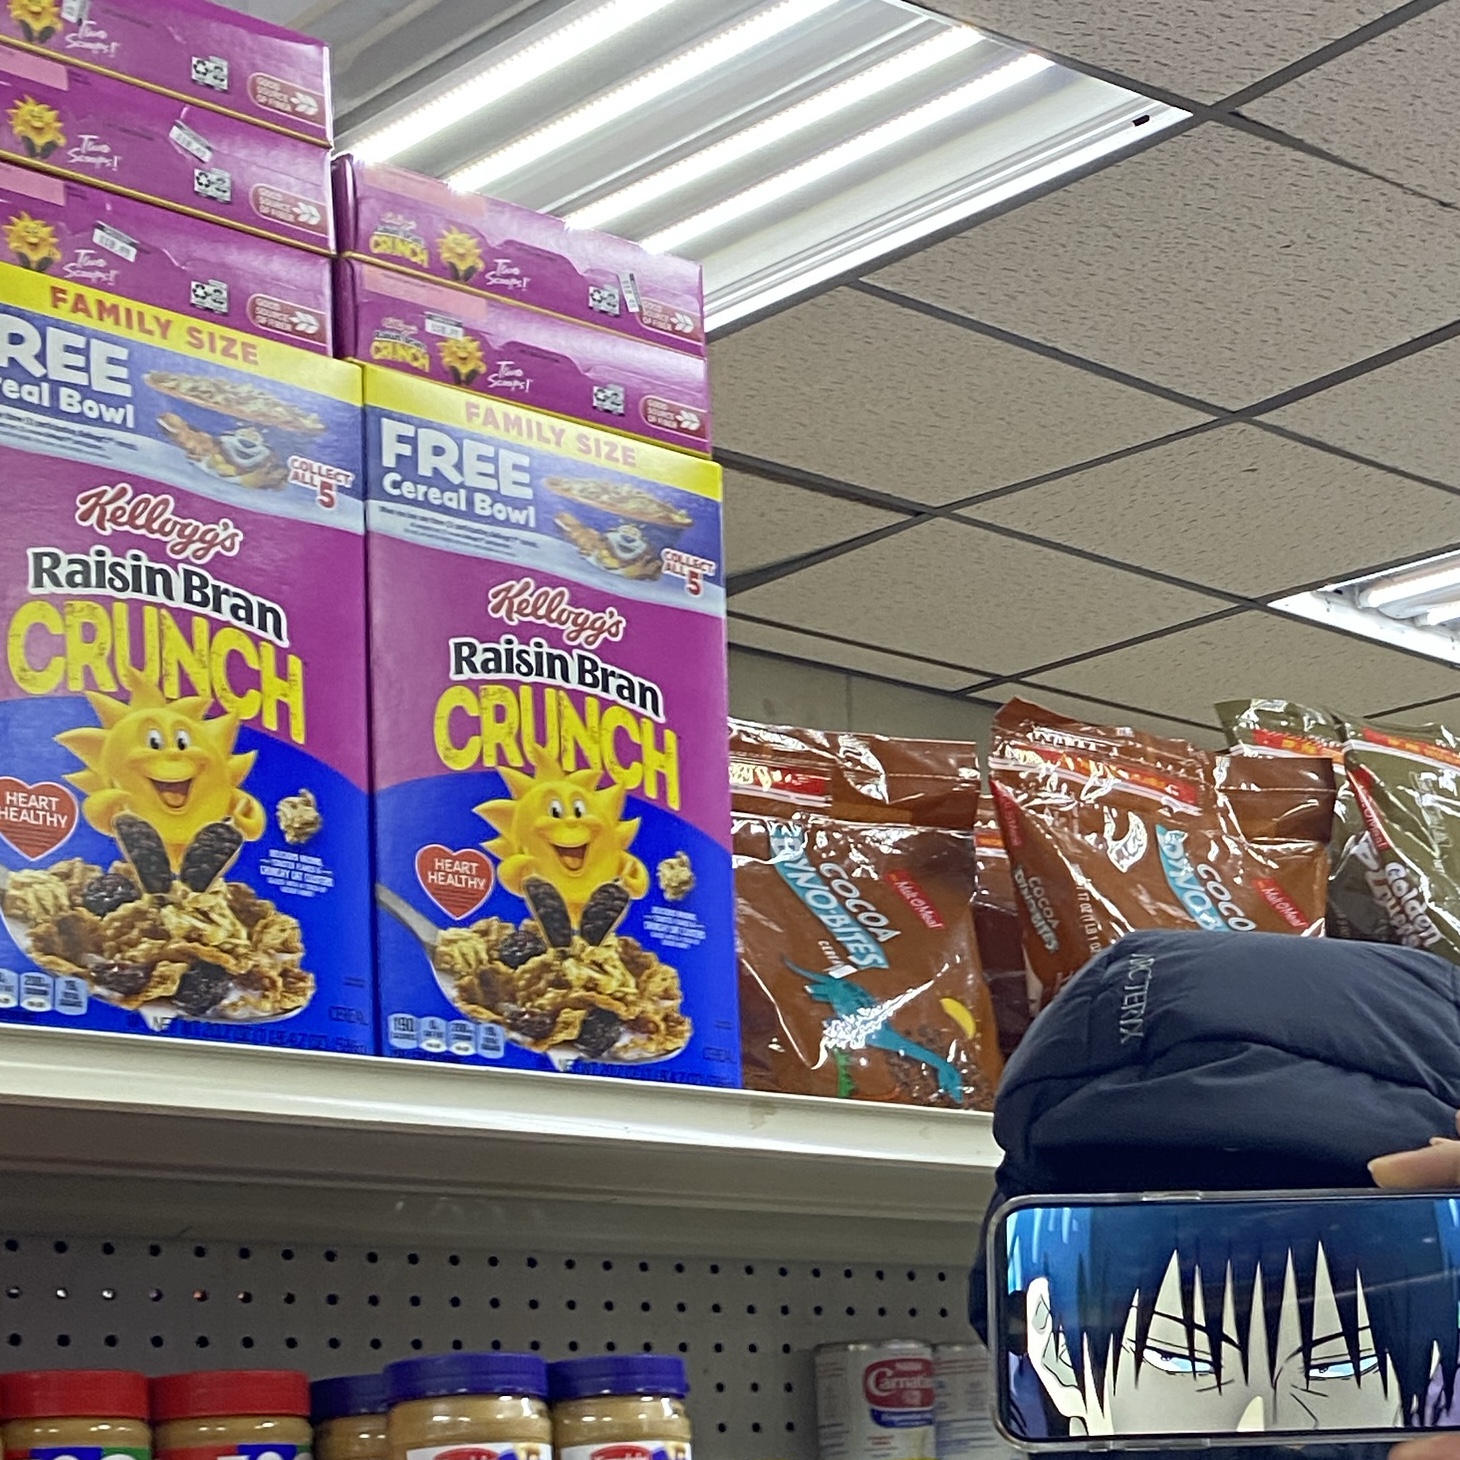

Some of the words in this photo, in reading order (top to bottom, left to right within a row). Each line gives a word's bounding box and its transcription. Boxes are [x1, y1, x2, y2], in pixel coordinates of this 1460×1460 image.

[0, 313, 132, 397] REE
[51, 286, 174, 340] FAMILY
[187, 326, 260, 366] SIZE
[0, 374, 49, 408] eal
[59, 387, 135, 428] Bowl
[381, 418, 533, 499] FREE
[465, 402, 565, 448] FAMILY
[576, 433, 637, 468] SIZE
[289, 457, 354, 488] COLLECT
[289, 470, 318, 488] ALL
[318, 482, 336, 510] 5
[383, 473, 466, 511] Cereal
[474, 492, 536, 528] Bowl
[77, 484, 241, 560] Kellogg's
[32, 549, 174, 601] Raisin
[183, 565, 282, 641] Bran
[662, 549, 715, 576] COLLECT
[686, 571, 702, 596] 5
[490, 580, 623, 646] Kellogg's
[7, 600, 305, 744] CRUNCH
[453, 637, 570, 684] Raisin
[577, 654, 660, 718] Bran
[434, 685, 680, 811] CRUNCH
[0, 808, 67, 829] HEALTHY
[7, 791, 59, 812] HEART
[427, 870, 486, 890] HEALTHY
[434, 857, 479, 875] HEART
[1157, 830, 1230, 931] DYNO-B
[1198, 863, 1257, 931] COCO
[819, 862, 901, 942] COCOA
[1028, 876, 1060, 930] COCOA
[1385, 862, 1443, 947] Golden
